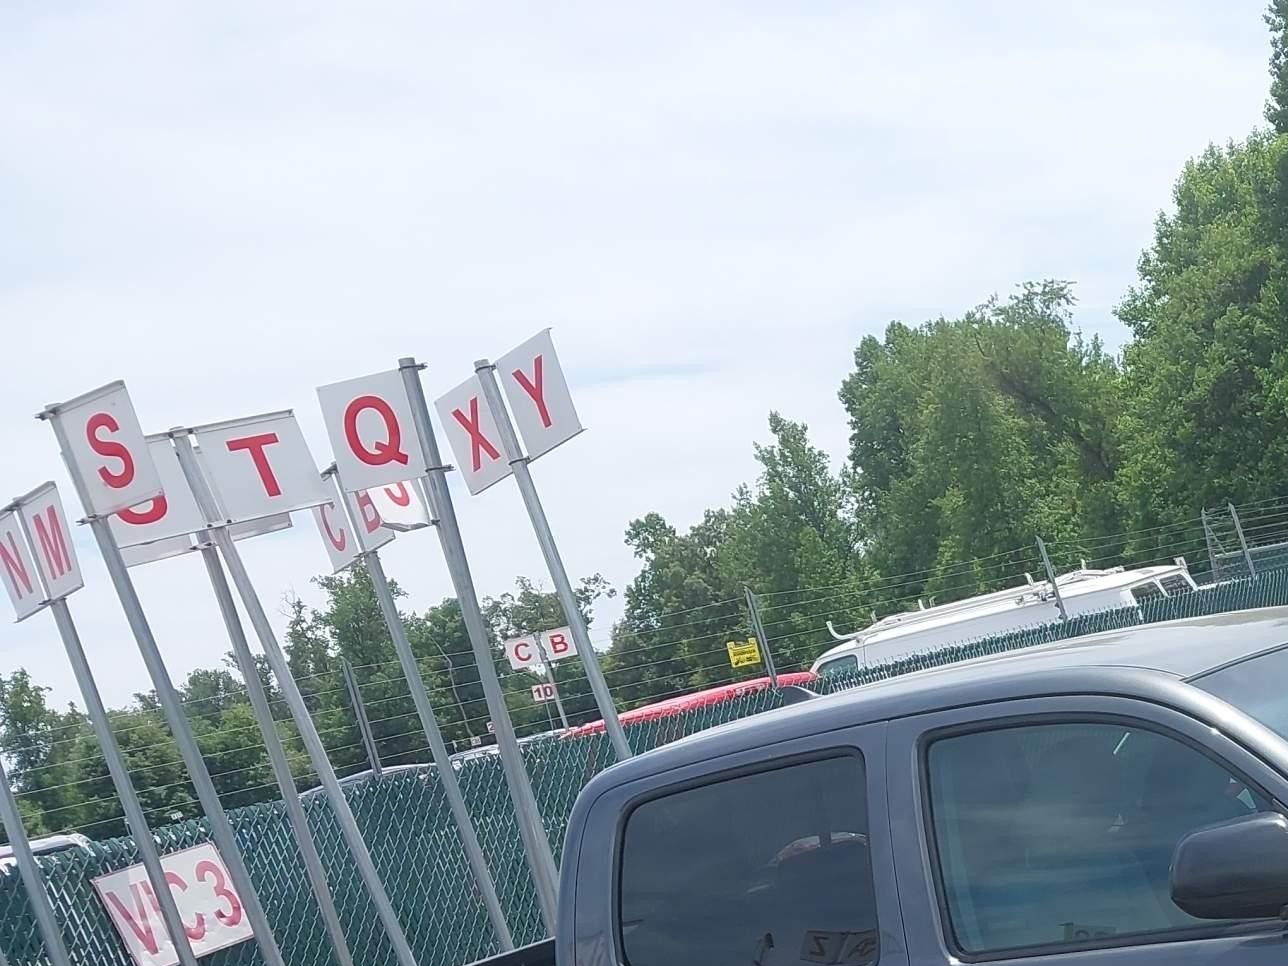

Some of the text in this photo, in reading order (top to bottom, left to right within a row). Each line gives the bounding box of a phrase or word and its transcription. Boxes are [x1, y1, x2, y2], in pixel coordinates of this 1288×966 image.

[511, 354, 552, 429] Y
[85, 412, 136, 490] S
[225, 432, 281, 498] T
[343, 394, 409, 467] Q
[451, 396, 501, 473] X
[0, 530, 34, 600] N
[33, 505, 72, 580] M
[514, 642, 532, 662] C
[549, 633, 569, 654] B
